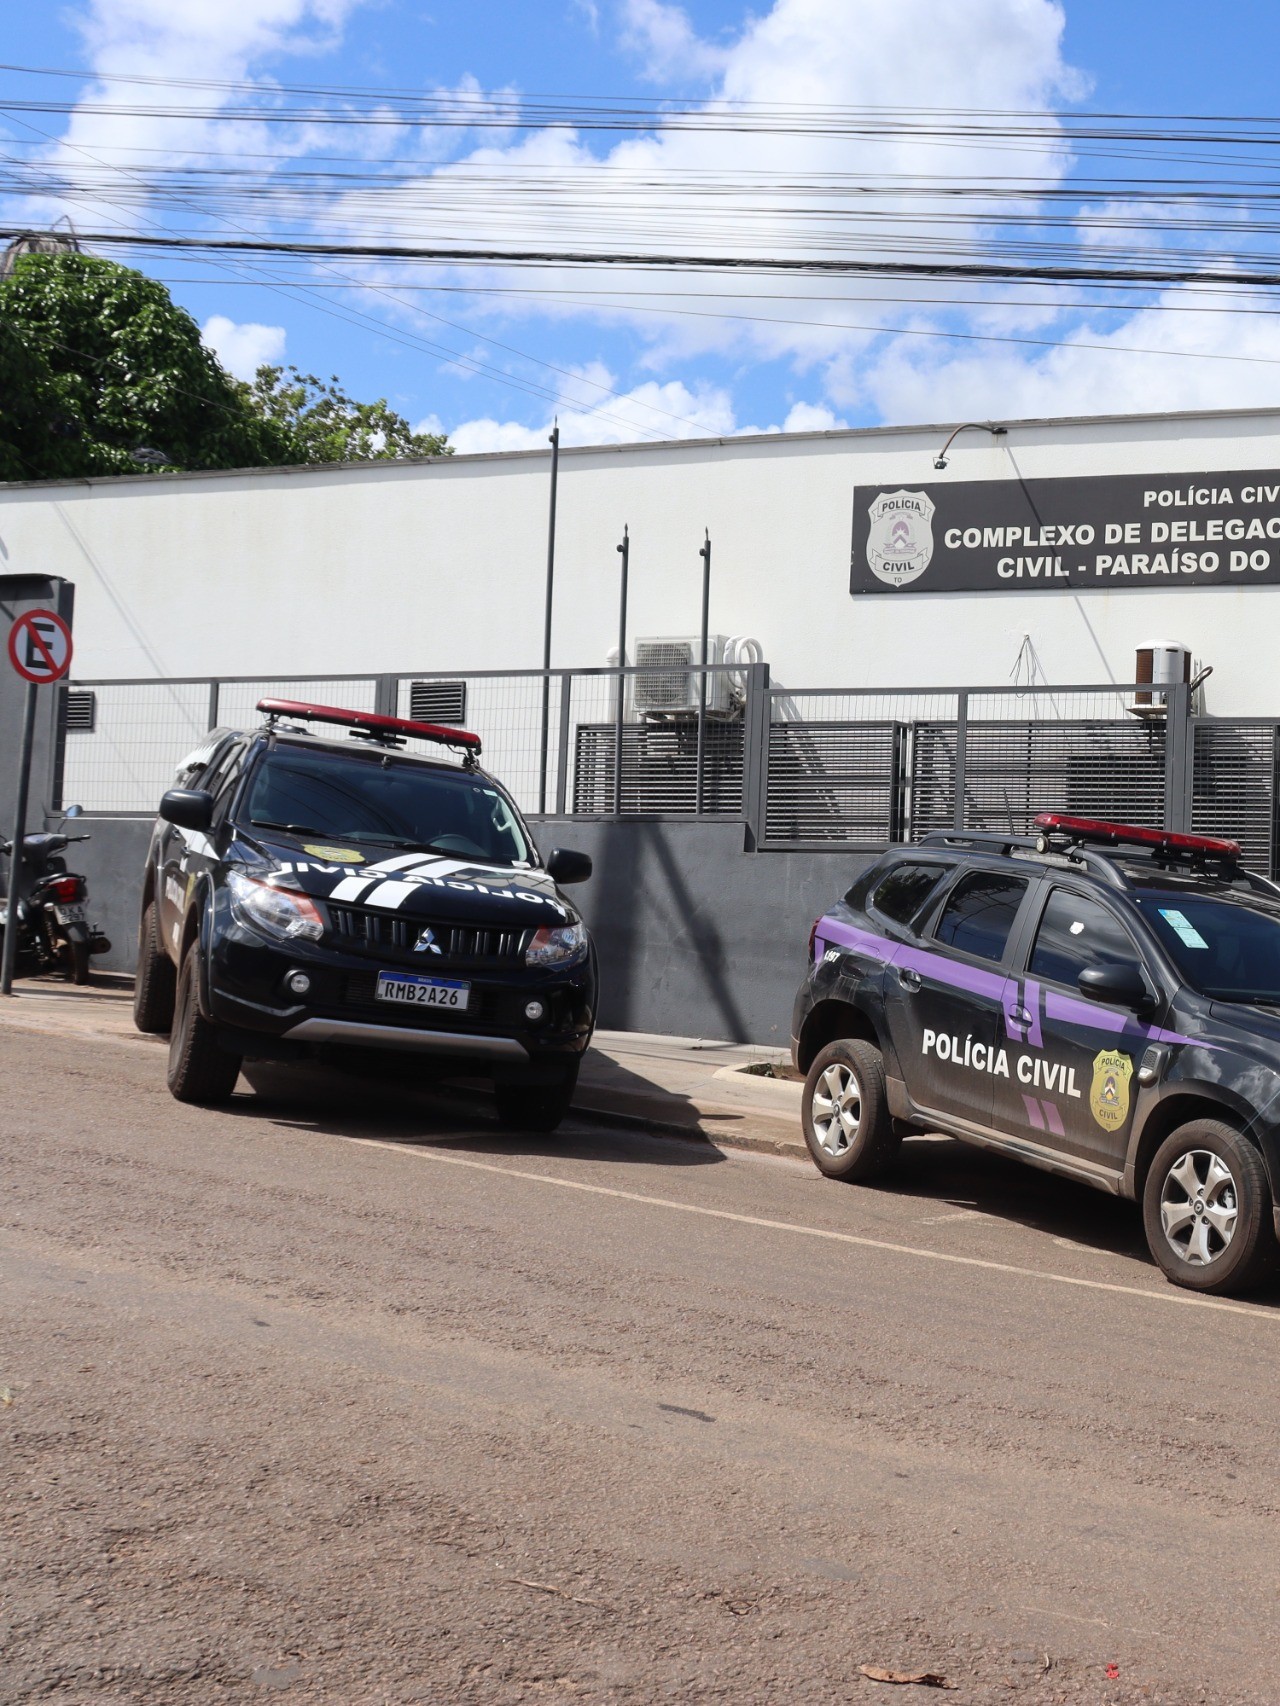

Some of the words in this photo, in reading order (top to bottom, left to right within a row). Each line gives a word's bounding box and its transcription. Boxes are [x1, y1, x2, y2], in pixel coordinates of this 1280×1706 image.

[881, 497, 922, 512] POLÍCIA
[1143, 486, 1234, 508] POLÍCIA
[944, 524, 1096, 549] COMPLEXO
[1104, 522, 1141, 545] DE
[882, 561, 915, 572] CIVIL
[997, 555, 1070, 578] CIVIL
[1095, 548, 1220, 576] PARAÍSO
[1229, 549, 1271, 572] DO
[25, 621, 55, 670] E
[384, 981, 458, 1006] RMB2A26
[921, 1028, 1010, 1079] POLÍCIA
[1016, 1054, 1082, 1099] CIVIL
[1098, 1109, 1118, 1120] CIVIL
